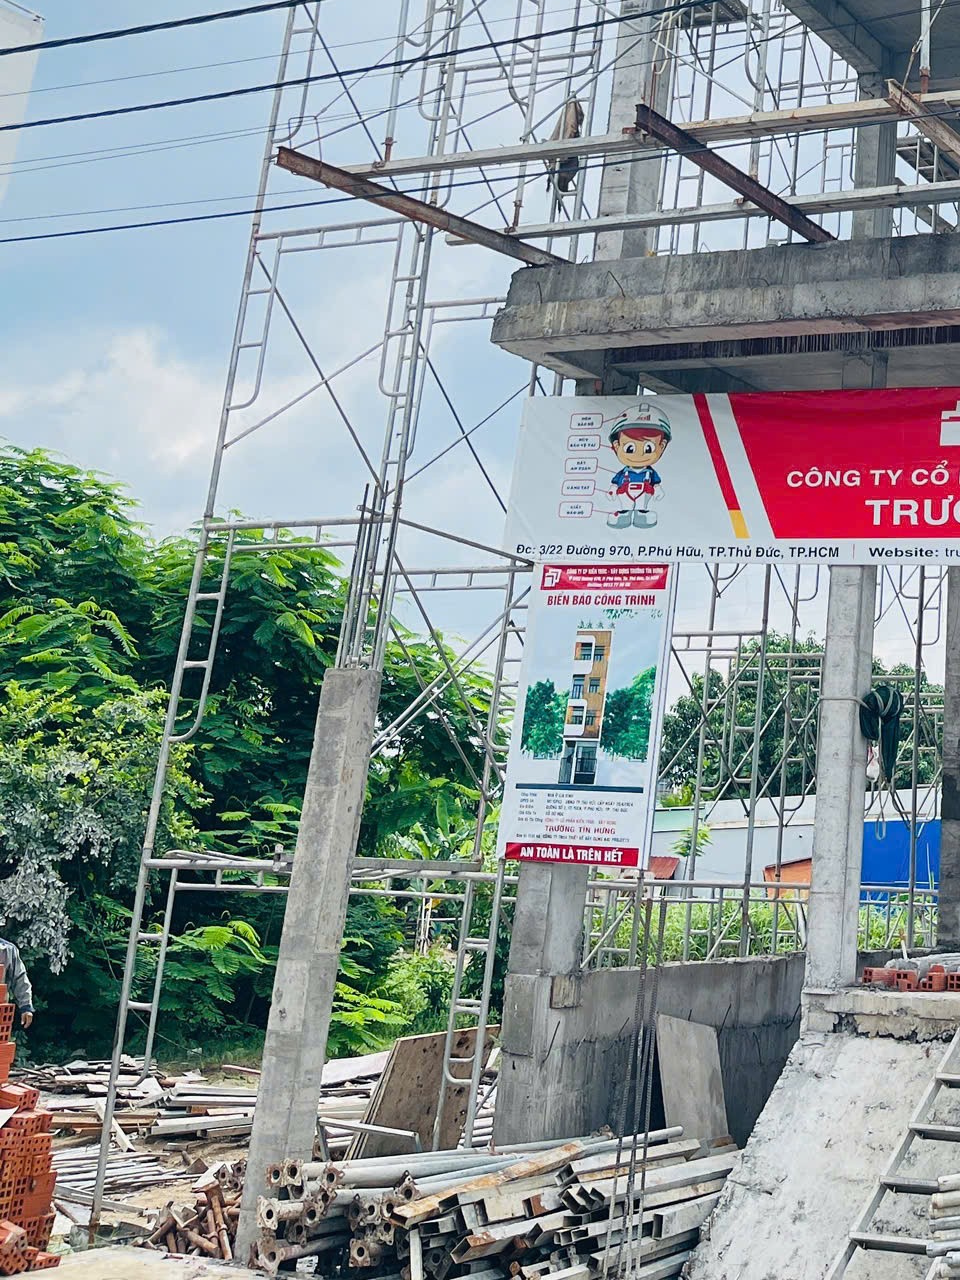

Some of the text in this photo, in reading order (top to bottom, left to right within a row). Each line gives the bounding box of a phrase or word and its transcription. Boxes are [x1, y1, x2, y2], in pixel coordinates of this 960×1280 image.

[786, 466, 862, 488] CÔNG
[870, 469, 903, 486] TY
[911, 459, 949, 486] CỔ
[516, 544, 840, 559] Đc: 3/22 Đường 970, P.Phú Hữu, TP.Thủ Đức, TP.HCM
[869, 547, 939, 558] Website:
[520, 845, 623, 863] AN TOÀN LÀ TRÊN HẾT
